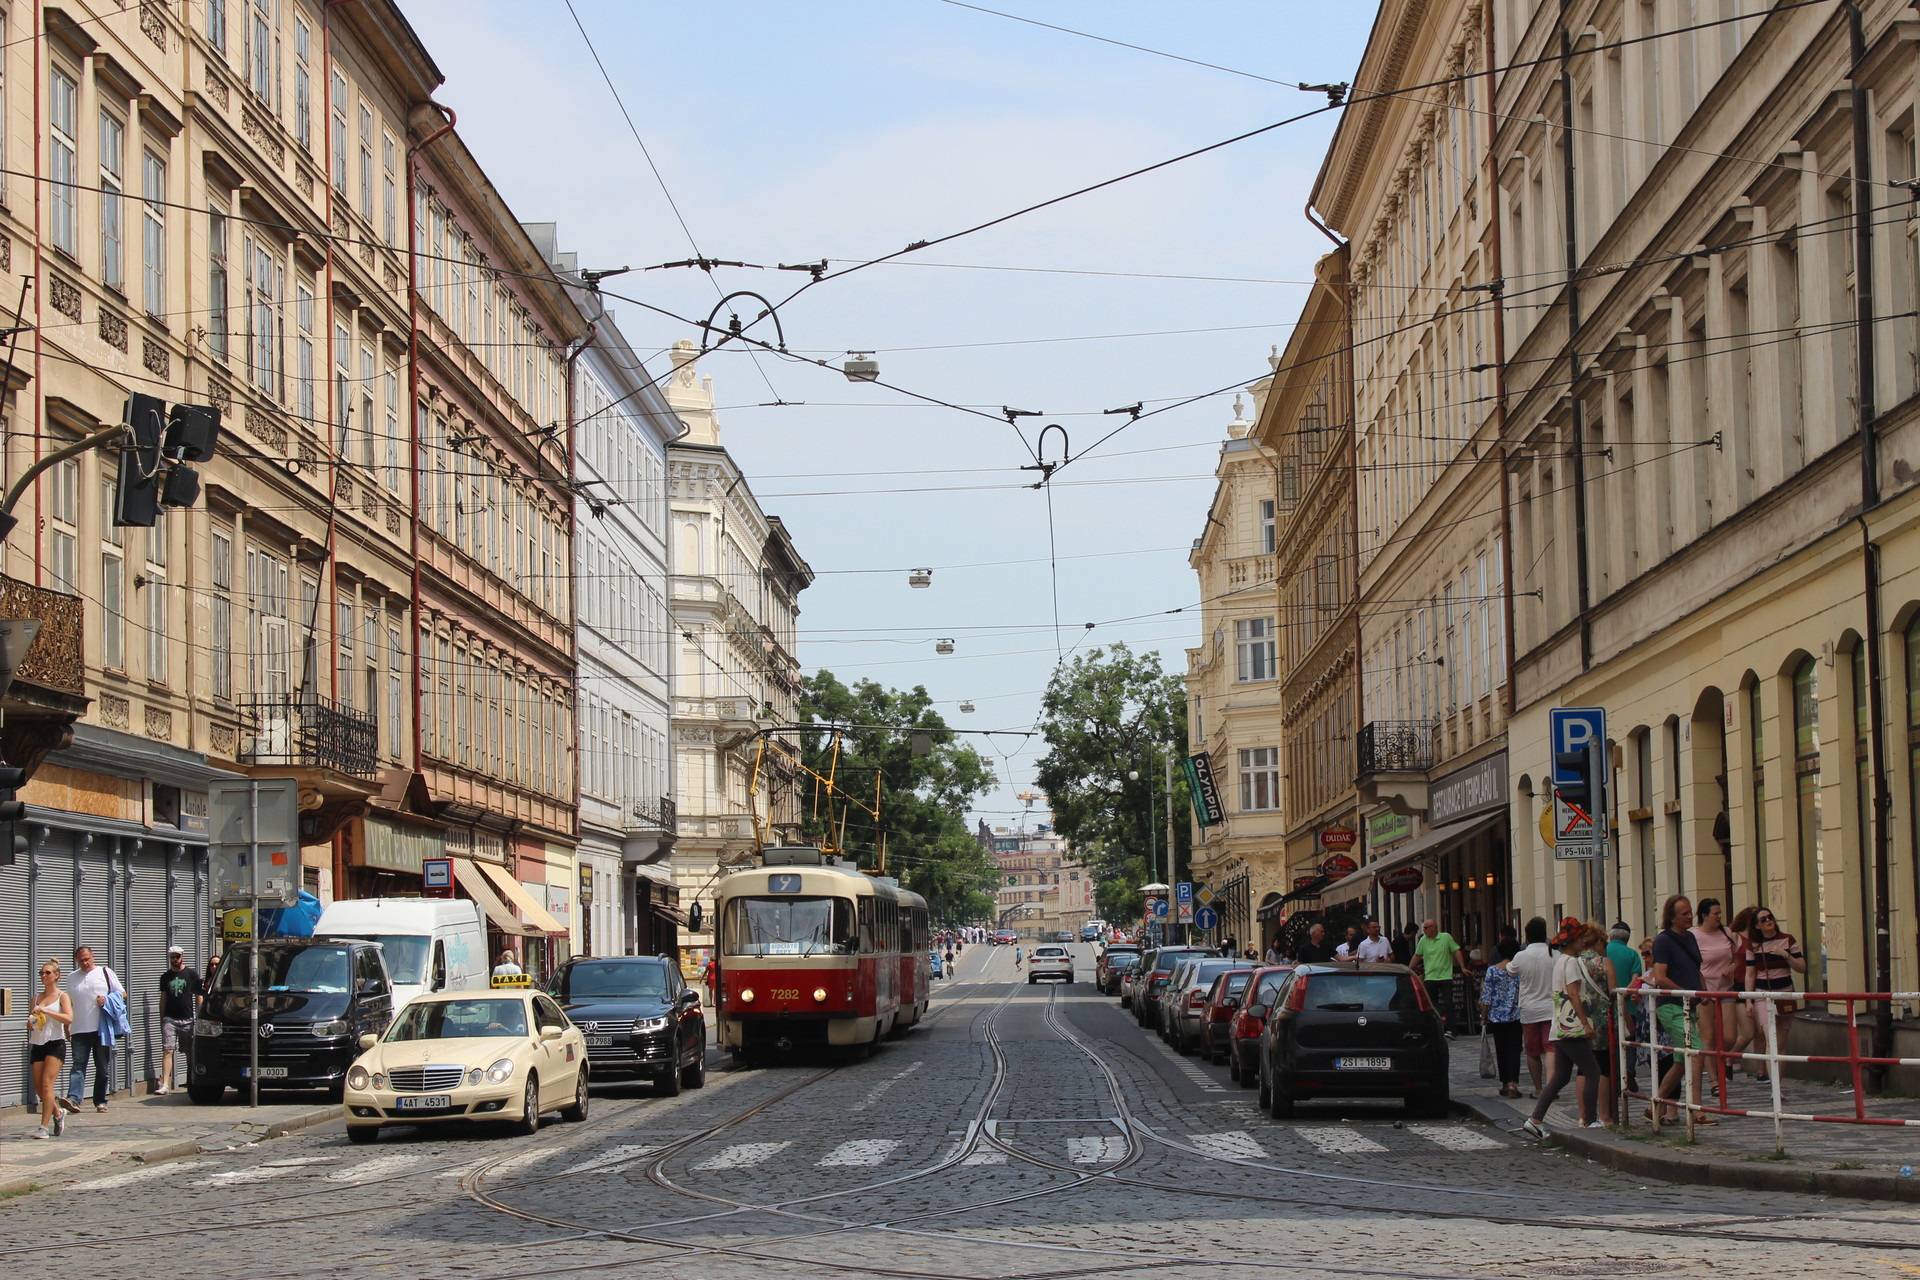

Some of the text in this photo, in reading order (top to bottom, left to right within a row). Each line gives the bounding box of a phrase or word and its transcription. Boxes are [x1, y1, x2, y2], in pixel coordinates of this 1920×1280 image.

[1562, 718, 1593, 753] P
[1195, 758, 1220, 819] OLYMPIA
[1433, 782, 1461, 820] RESTAURACE
[1325, 833, 1352, 842] DUDÁK
[779, 875, 792, 891] 9
[496, 974, 525, 983] TAXI
[770, 989, 799, 1000] 7282
[1367, 1058, 1387, 1067] 1895
[403, 1097, 446, 1108] 4AT 4531
